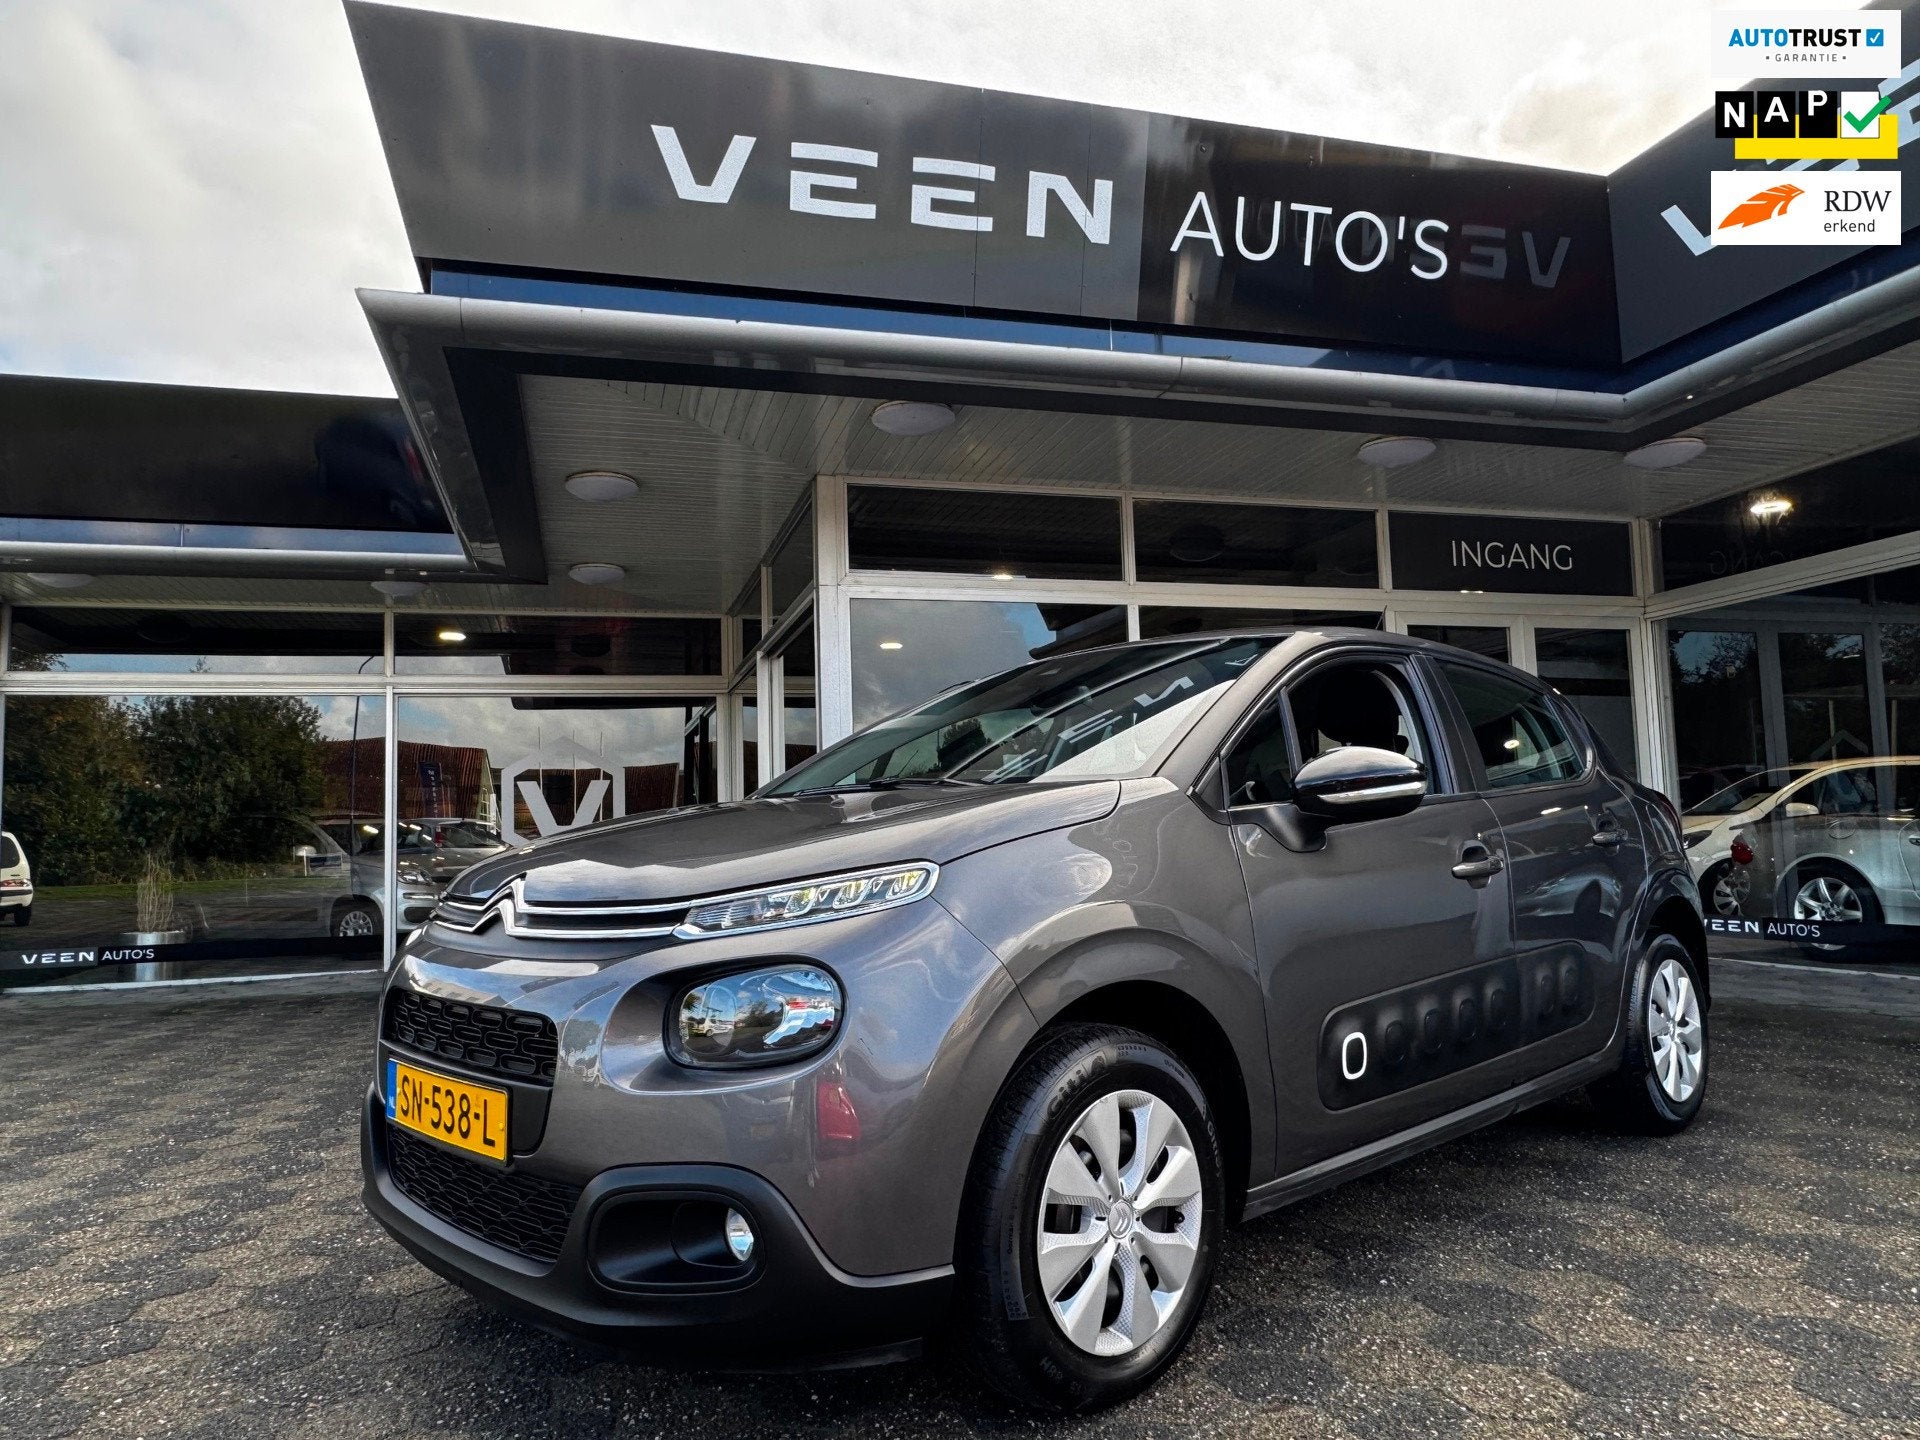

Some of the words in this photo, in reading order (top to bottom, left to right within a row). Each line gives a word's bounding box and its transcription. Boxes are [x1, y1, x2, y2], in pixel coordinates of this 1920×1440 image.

[650, 124, 1113, 245] VEEN
[1170, 191, 1449, 280] AUTO'S
[1452, 540, 1573, 570] INGANG
[1767, 922, 1821, 937] AUTO'S
[22, 951, 95, 965] VEEN
[101, 949, 155, 961] AUTO'S
[400, 1074, 496, 1148] SN-538-L
